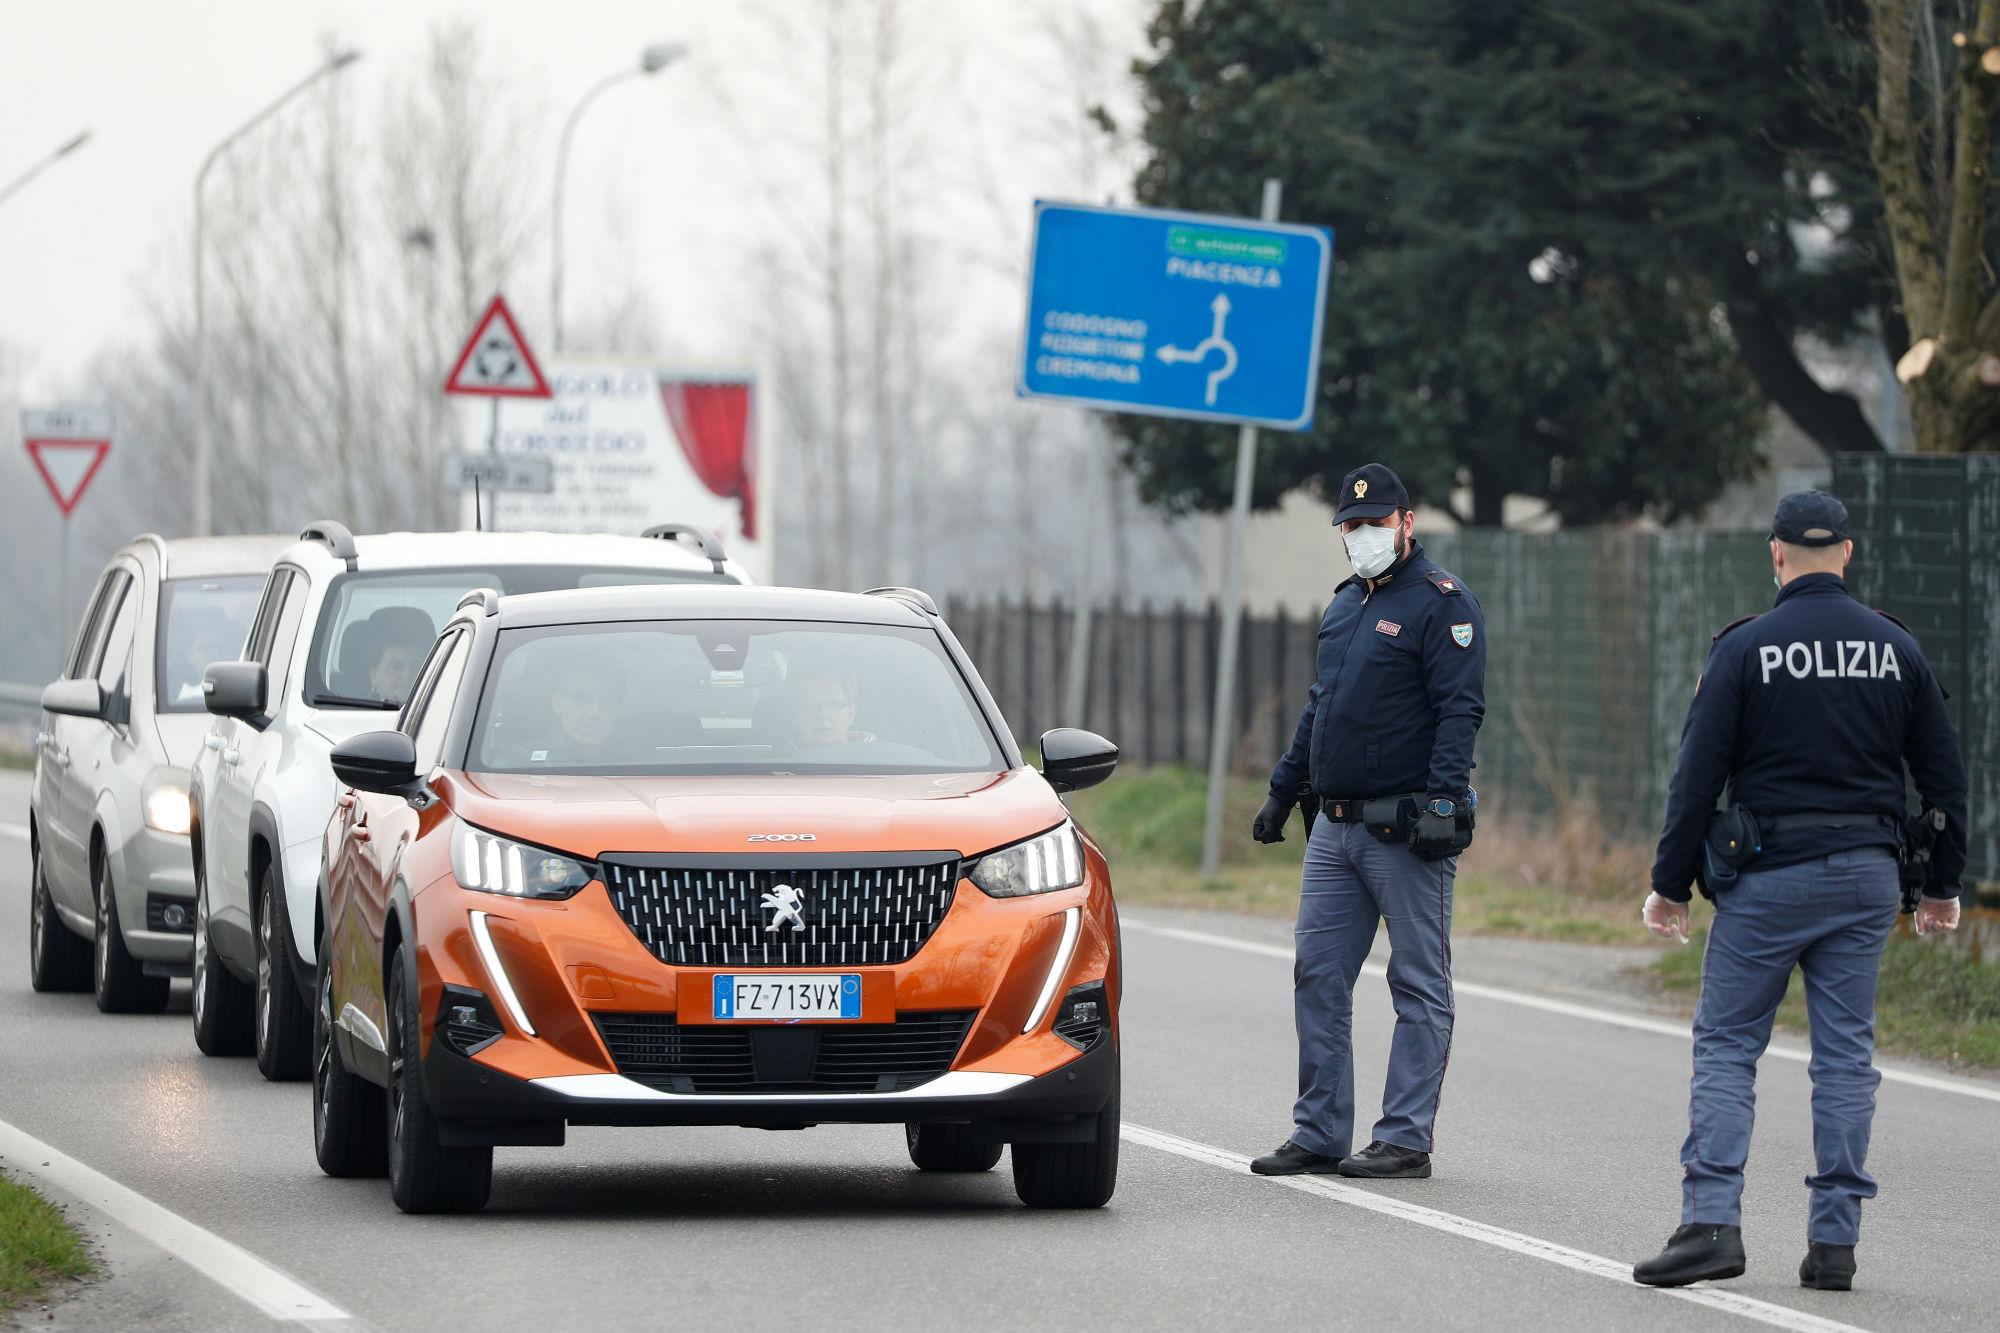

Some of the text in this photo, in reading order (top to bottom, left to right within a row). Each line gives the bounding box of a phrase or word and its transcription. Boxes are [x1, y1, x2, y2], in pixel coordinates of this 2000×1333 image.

[1167, 257, 1281, 288] PIACENZA
[1044, 310, 1147, 340] CODOGNO
[1036, 355, 1140, 384] CREMONA
[1759, 640, 1901, 684] POLIZIA
[747, 834, 817, 842] 2008
